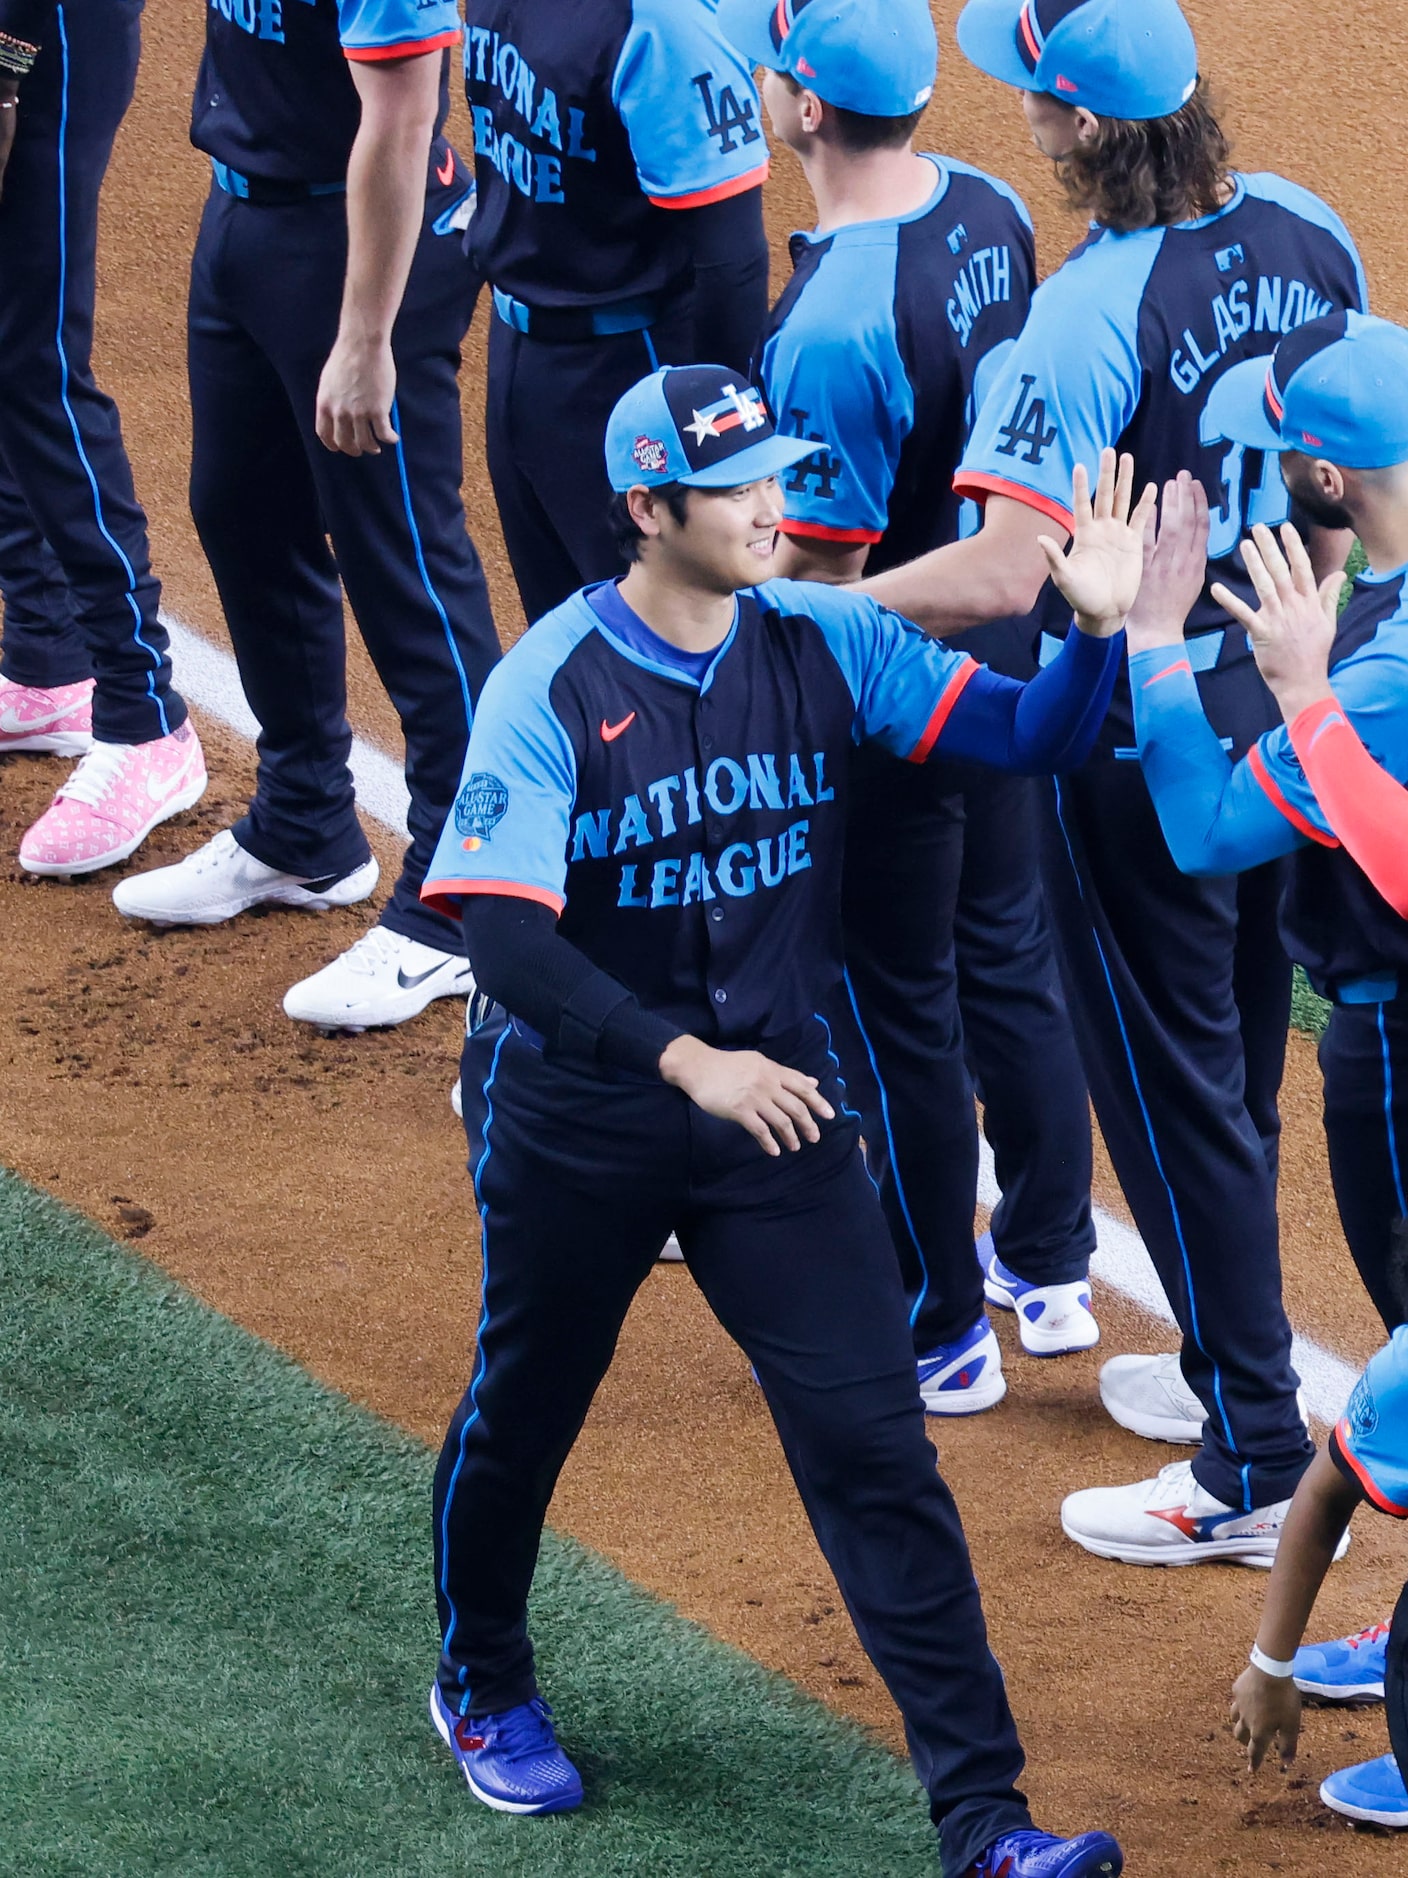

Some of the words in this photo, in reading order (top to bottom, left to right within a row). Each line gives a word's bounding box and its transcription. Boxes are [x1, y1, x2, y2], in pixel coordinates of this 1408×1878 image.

[692, 71, 760, 155] LA
[945, 245, 1011, 348] SMITH
[994, 374, 1058, 465] LA
[463, 803, 496, 817] GAME
[570, 751, 835, 863] NATIONAL
[616, 819, 813, 910] LEAGUE
